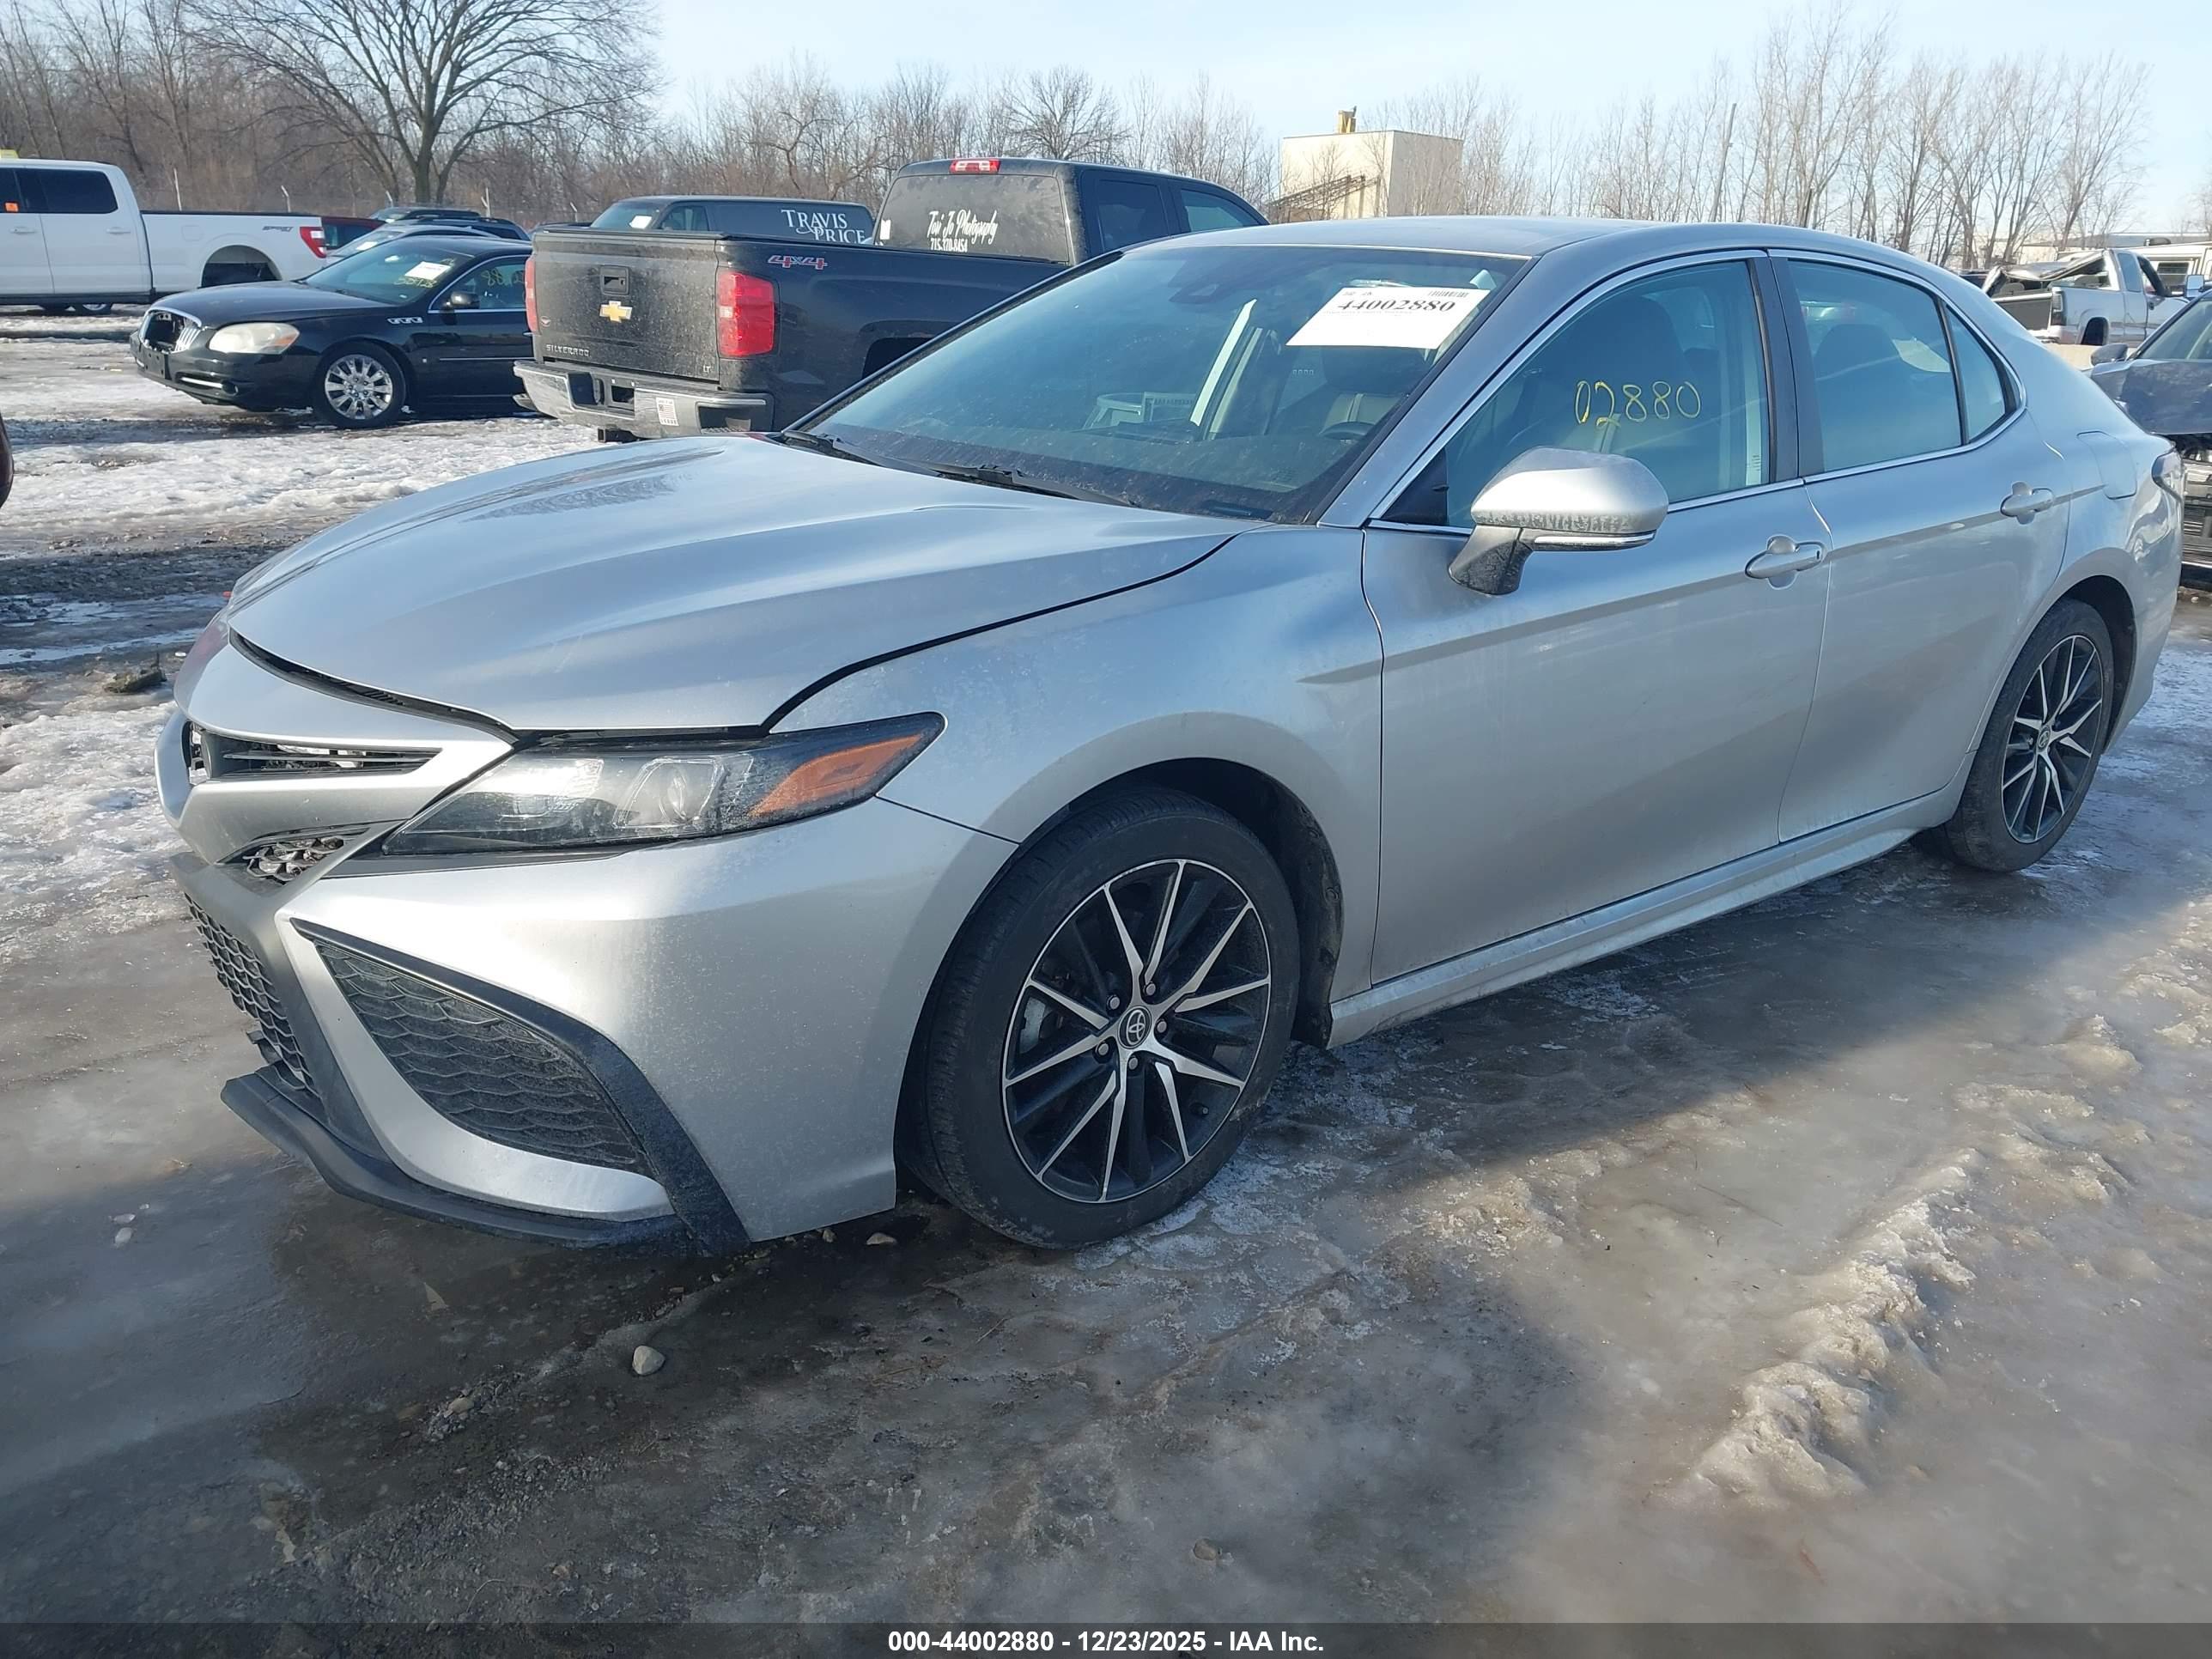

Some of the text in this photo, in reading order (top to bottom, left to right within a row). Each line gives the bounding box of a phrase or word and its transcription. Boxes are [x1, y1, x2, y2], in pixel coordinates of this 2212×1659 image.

[781, 210, 848, 234] TRAVIS
[943, 210, 955, 238] Jo
[955, 210, 999, 245] Photography
[813, 227, 866, 244] PRICE
[1337, 300, 1455, 313] 44002880
[545, 344, 591, 357] SILVERADO
[702, 364, 712, 373] LT
[1575, 380, 1702, 428] 02880
